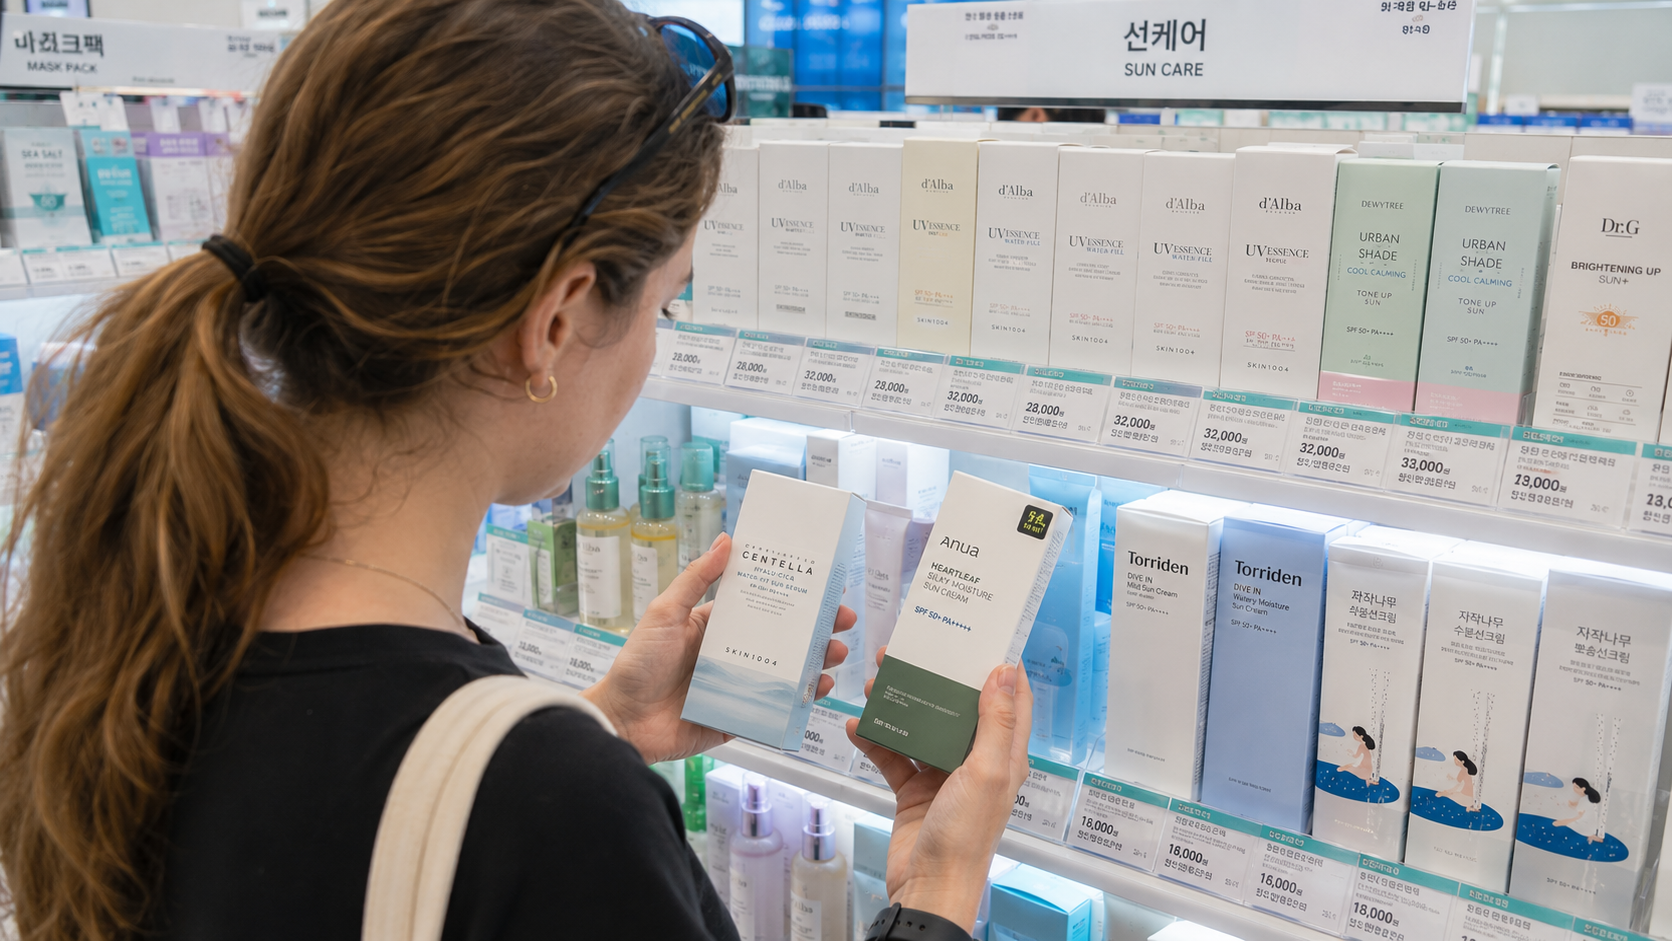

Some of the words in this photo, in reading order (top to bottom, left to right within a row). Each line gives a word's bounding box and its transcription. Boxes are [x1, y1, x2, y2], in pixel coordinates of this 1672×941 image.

[1123, 17, 1206, 52] 선케어
[28, 61, 62, 73] MASK
[65, 62, 97, 74] PACK
[1124, 62, 1158, 78] SUN
[1161, 62, 1204, 77] CARE
[717, 183, 738, 195] Alba
[778, 179, 807, 190] d'Alba
[849, 182, 879, 194] d'Alba
[921, 178, 954, 191] d'Alba
[998, 184, 1033, 197] d'Alba
[1080, 192, 1117, 205] d'Alba
[1165, 197, 1205, 211] d'Alba
[1259, 197, 1302, 212] d'Alba
[1362, 200, 1405, 210] DEWYTREE
[1464, 205, 1512, 216] DEWYTREE
[1600, 217, 1640, 235] Dr.G
[1359, 231, 1400, 244] URBAN
[1461, 238, 1507, 252] URBAN
[1358, 248, 1397, 262] SHADE
[1460, 255, 1503, 269] SHADE
[1570, 261, 1643, 275] BRIGHTENING
[1645, 266, 1662, 276] UP
[1347, 267, 1369, 276] COOL
[1370, 269, 1407, 279] CALMING
[1447, 274, 1472, 284] COOL
[1473, 277, 1513, 287] CALMING
[1598, 275, 1630, 285] SUN+
[1357, 290, 1380, 299] TONE
[1458, 297, 1482, 307] TONE
[1484, 300, 1497, 308] UP
[1467, 306, 1485, 315] SUN
[1246, 361, 1290, 373] SKIN1004
[940, 536, 980, 558] Anua
[742, 550, 813, 576] CENTELLA
[1128, 550, 1189, 576] Torriden
[931, 562, 981, 584] HEARTLEAF
[1127, 572, 1144, 582] DIVE
[1145, 576, 1153, 584] IN
[1235, 560, 1303, 587] Torriden
[923, 581, 940, 593] SUN
[1155, 588, 1178, 598] Cream
[1233, 583, 1251, 594] DIVE
[914, 605, 928, 616] SPF
[1459, 610, 1504, 629] 자작나무
[1576, 626, 1632, 648] 자작나무
[724, 646, 778, 667] SKIN1004
